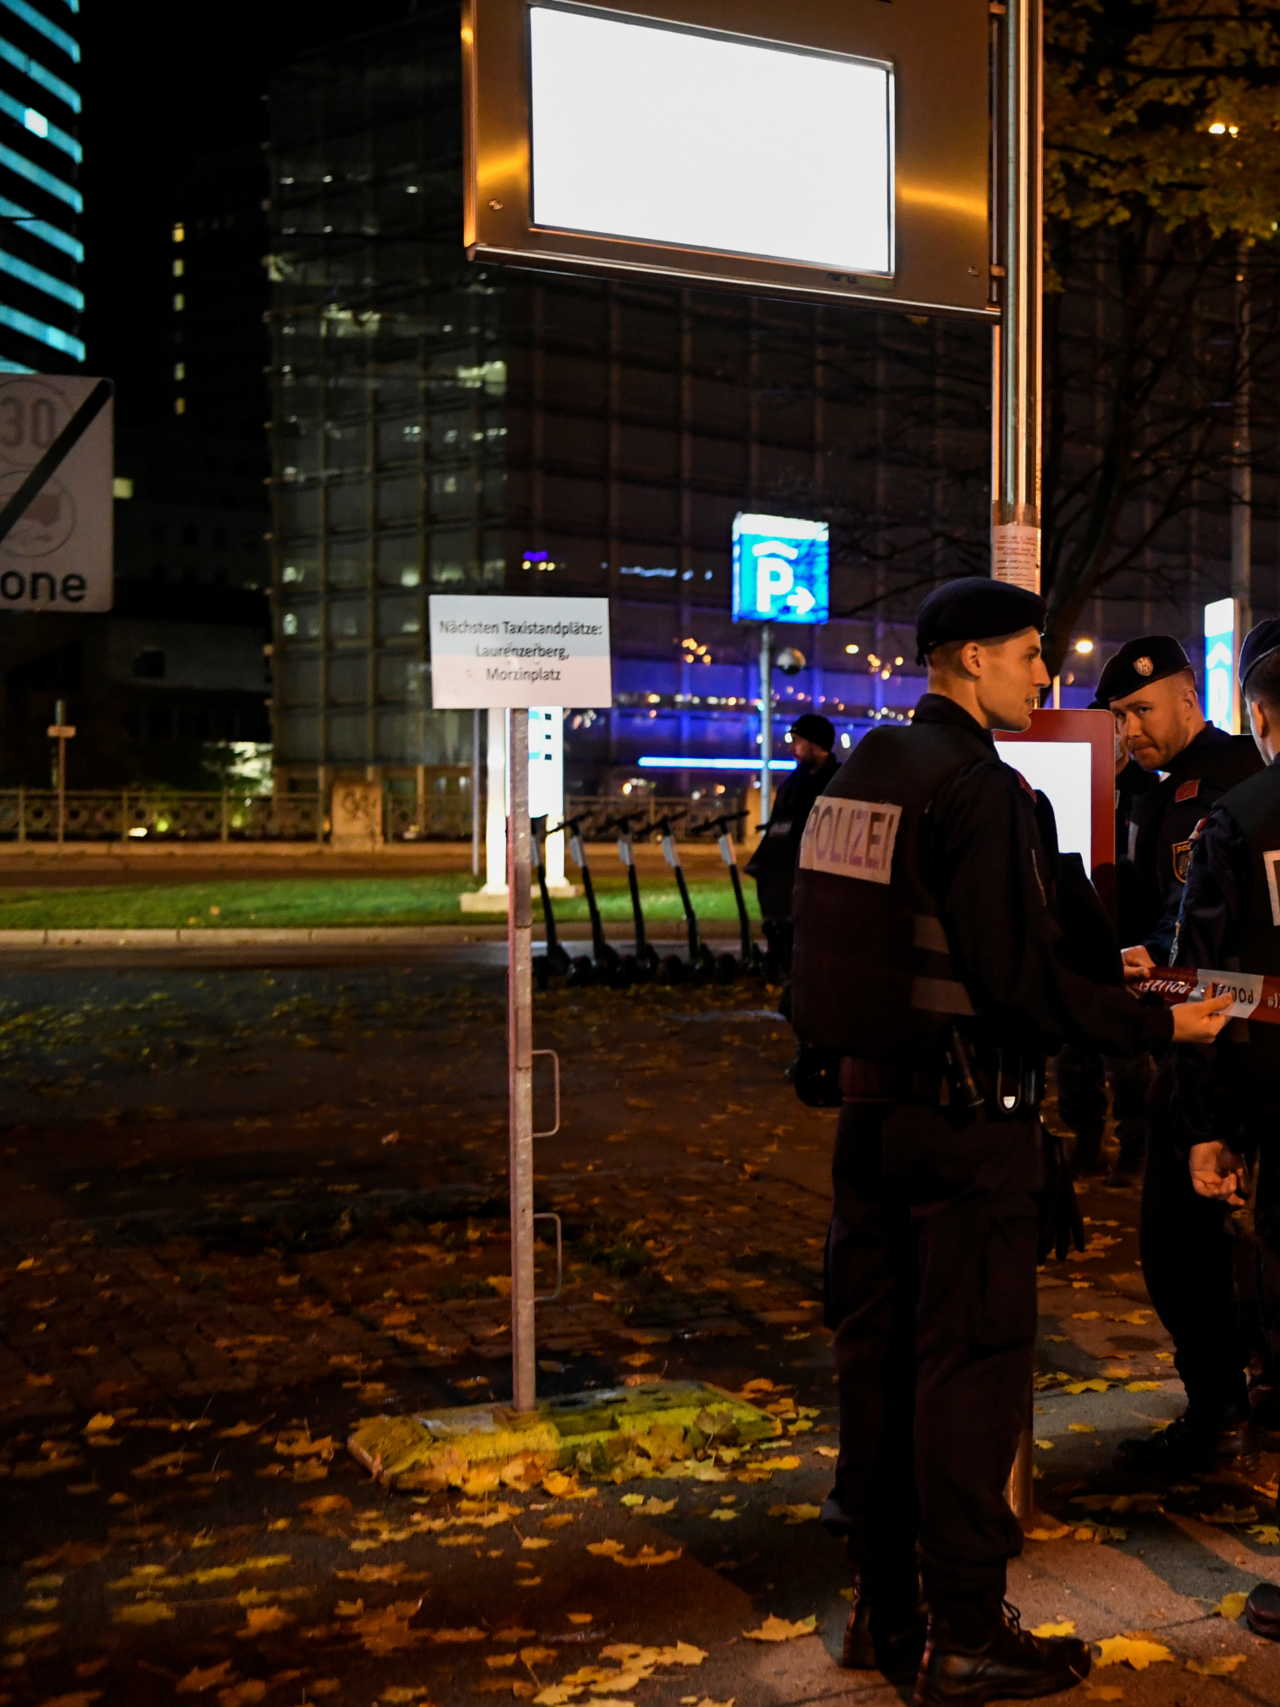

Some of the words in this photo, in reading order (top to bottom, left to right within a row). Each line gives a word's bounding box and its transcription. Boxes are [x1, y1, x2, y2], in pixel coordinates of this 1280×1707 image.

[0, 397, 56, 449] 30
[756, 556, 794, 612] P
[439, 620, 498, 635] Nächsten
[502, 620, 603, 637] Taxistandplätze:
[475, 643, 570, 660] Laurenzerberg,
[486, 667, 561, 683] Morzinplatz
[805, 804, 896, 870] POLIZEI
